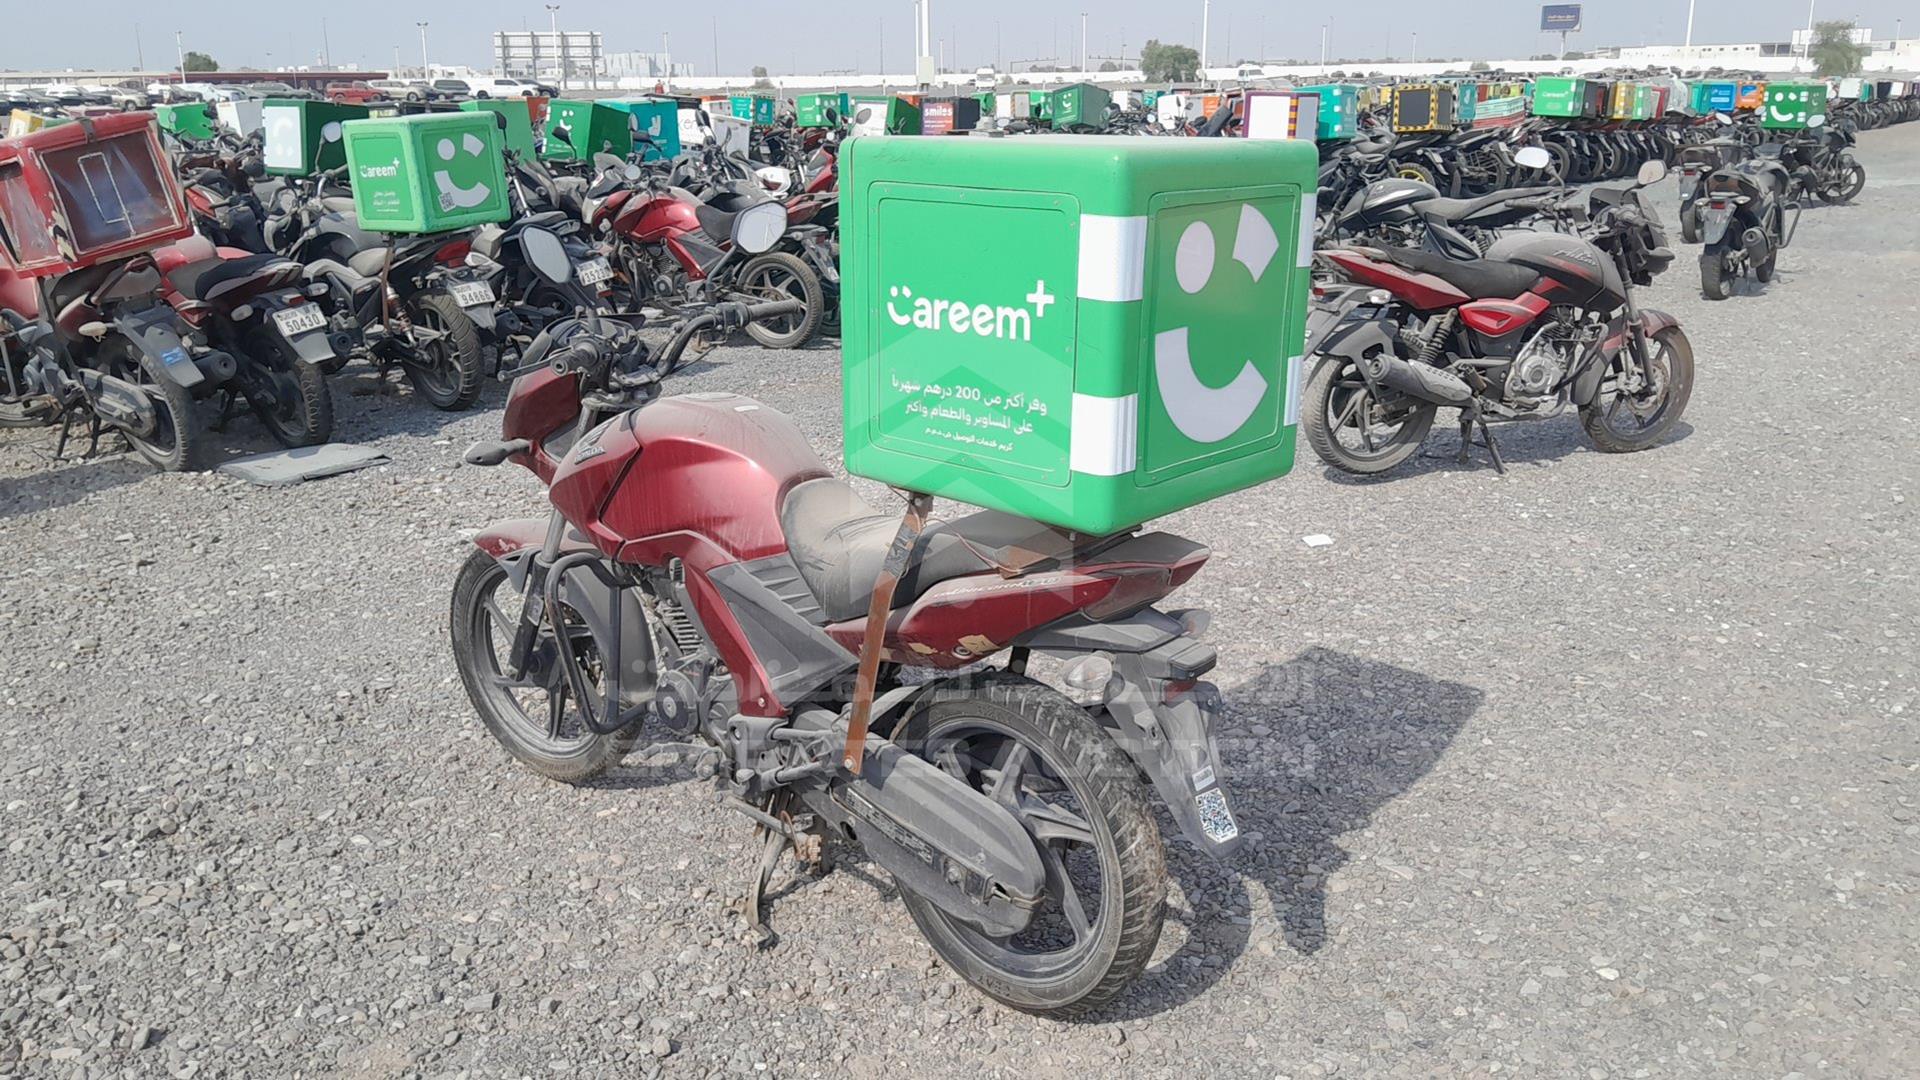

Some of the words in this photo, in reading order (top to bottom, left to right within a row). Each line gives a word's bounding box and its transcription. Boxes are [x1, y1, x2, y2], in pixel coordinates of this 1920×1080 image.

[924, 105, 953, 117] smiles
[285, 313, 321, 332] 50430
[923, 384, 953, 400] درهم
[955, 386, 981, 401] 200
[983, 395, 1002, 407] من
[930, 405, 972, 425] والطعام
[1013, 421, 1033, 436] على
